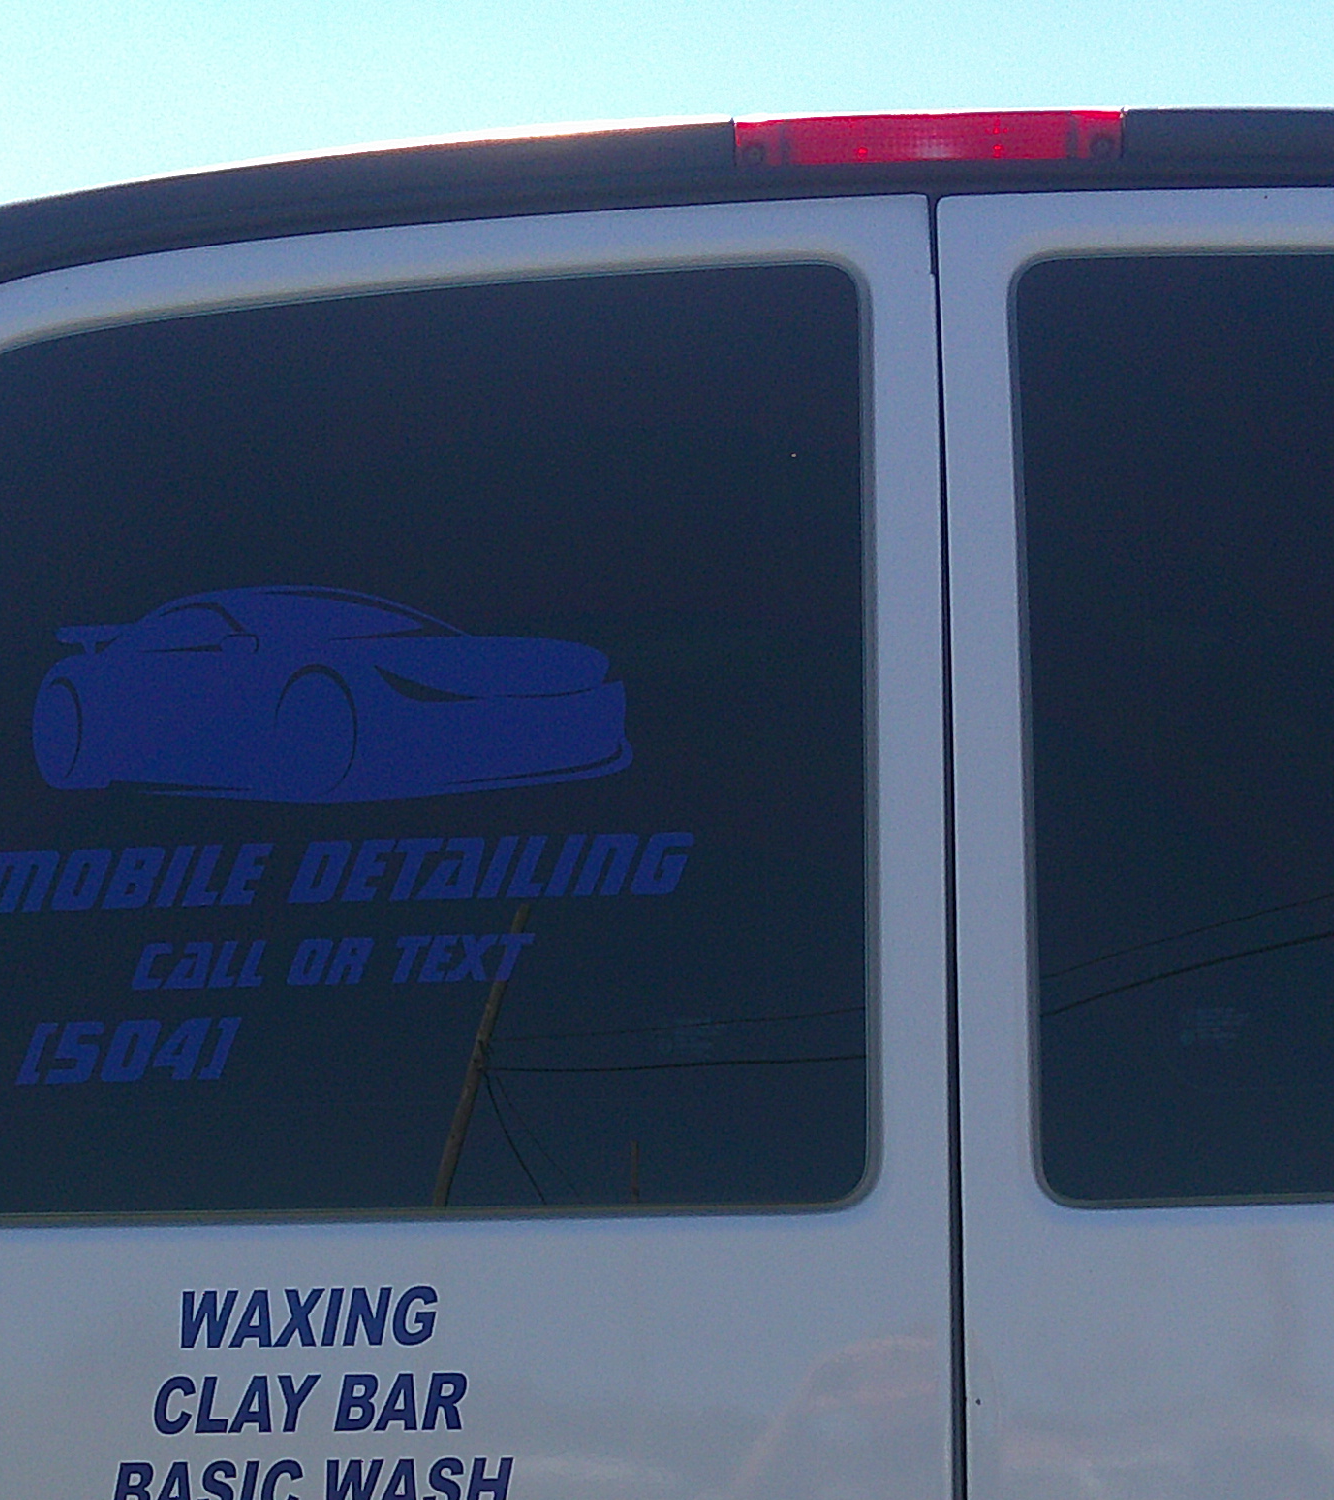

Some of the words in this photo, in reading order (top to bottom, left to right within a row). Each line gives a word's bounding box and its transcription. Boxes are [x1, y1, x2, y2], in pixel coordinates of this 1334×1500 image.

[288, 832, 694, 904] DETAILING
[132, 942, 265, 990] CALL
[287, 938, 373, 986] OR
[392, 933, 535, 983] TEXT
[181, 1286, 437, 1348] WAXING
[154, 1375, 320, 1434] CLAY
[334, 1373, 467, 1431] BAR
